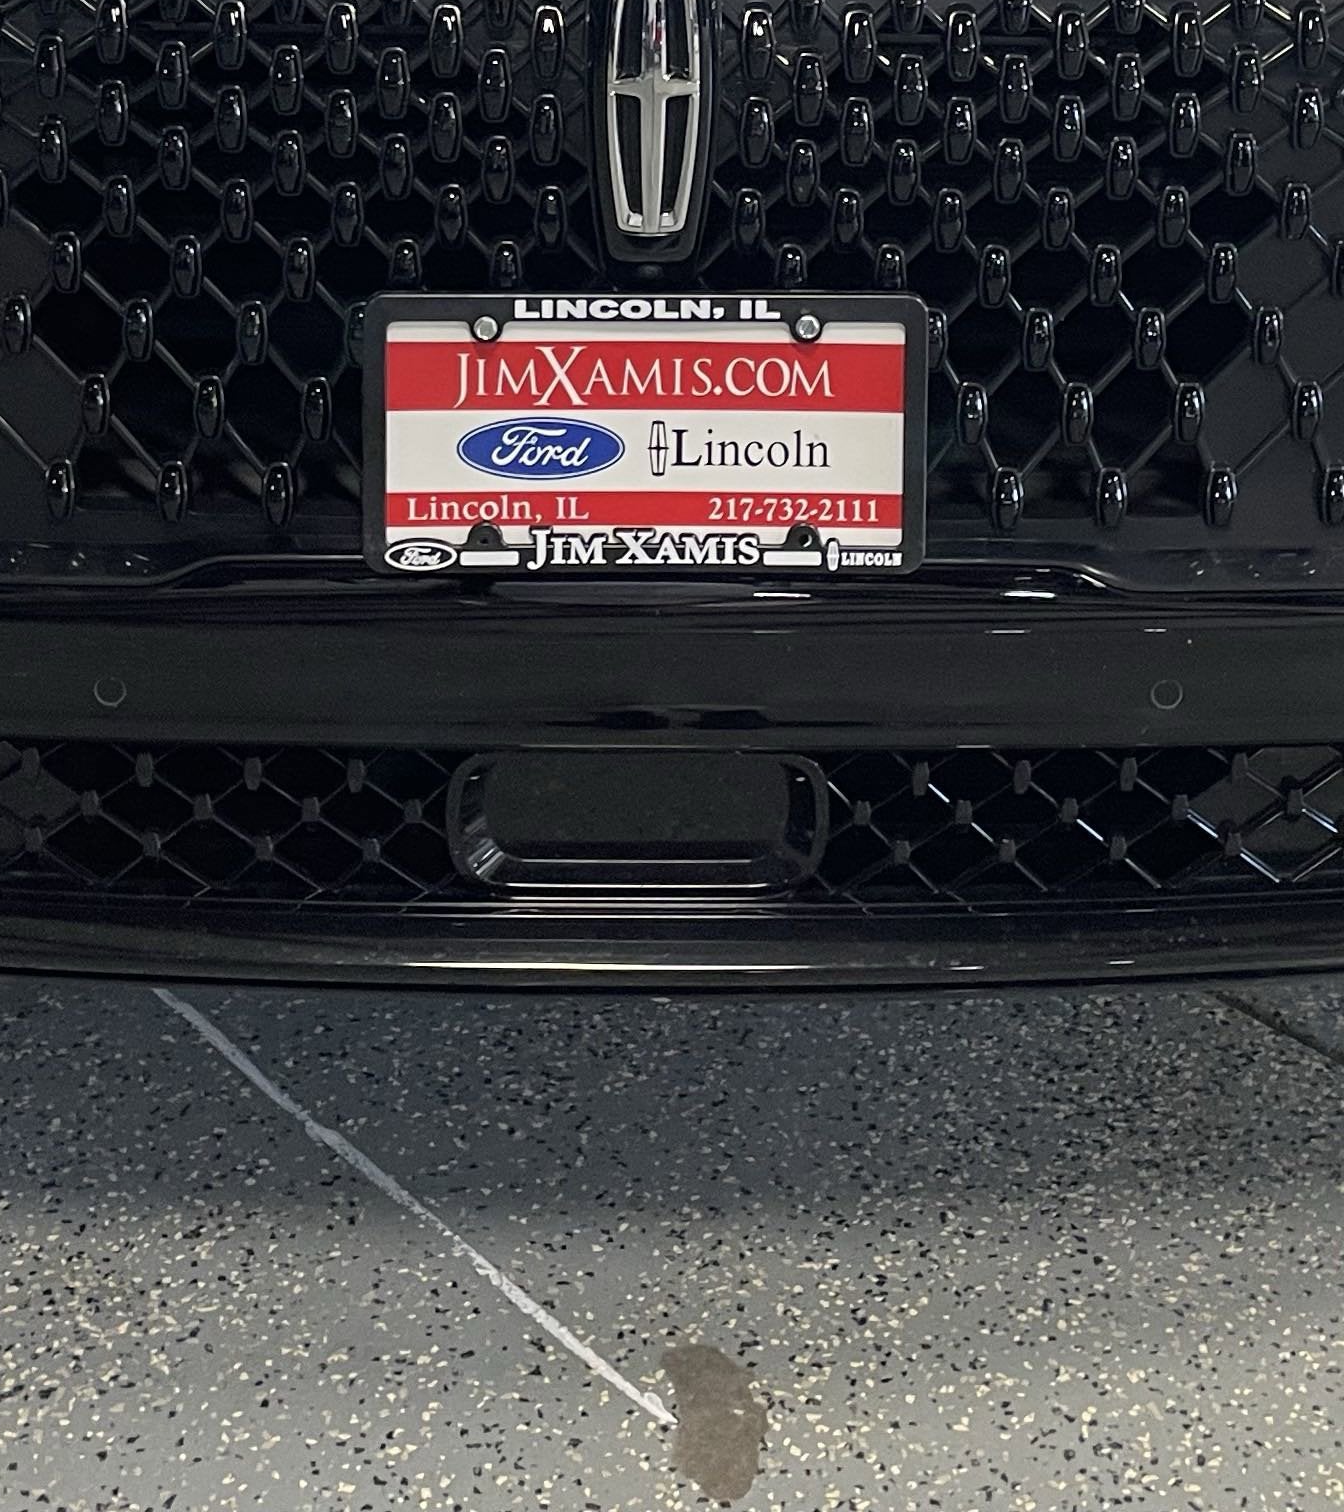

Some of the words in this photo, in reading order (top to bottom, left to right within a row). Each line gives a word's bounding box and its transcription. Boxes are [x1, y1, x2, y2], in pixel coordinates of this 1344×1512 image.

[514, 299, 723, 320] LINCOLN,
[739, 300, 781, 320] IL
[454, 346, 834, 408] JIMXAMIS.COM
[491, 425, 591, 468] Ford
[671, 429, 830, 469] Lincoln
[407, 496, 542, 523] Lincoln,
[556, 496, 589, 520] IL
[709, 497, 879, 523] 217-732-2111
[400, 547, 441, 566] Ford
[527, 529, 607, 569] JIM
[615, 530, 760, 567] XAMIS
[841, 552, 902, 566] LINCOLN
